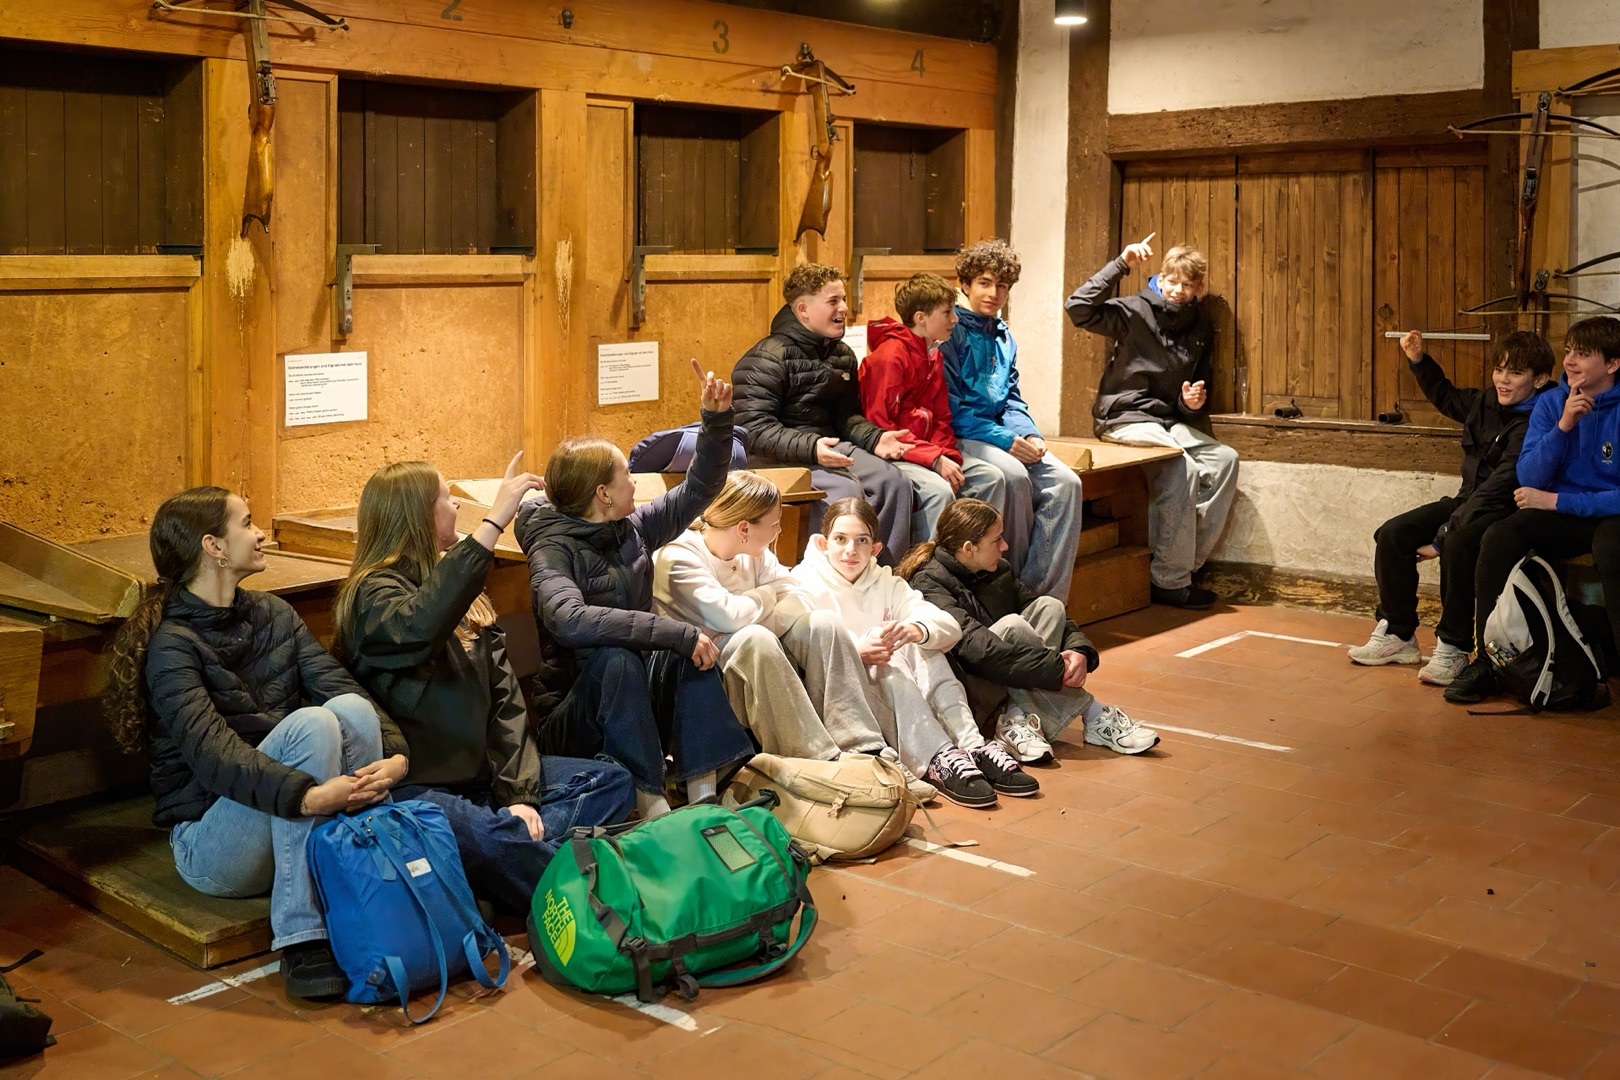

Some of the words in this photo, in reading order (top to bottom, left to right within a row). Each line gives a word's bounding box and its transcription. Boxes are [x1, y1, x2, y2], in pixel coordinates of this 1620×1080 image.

[440, 0, 463, 21] 2
[712, 20, 730, 54] 3
[910, 48, 926, 78] 4
[542, 909, 559, 944] FACE
[545, 889, 566, 937] NORTH
[557, 896, 574, 926] THE
